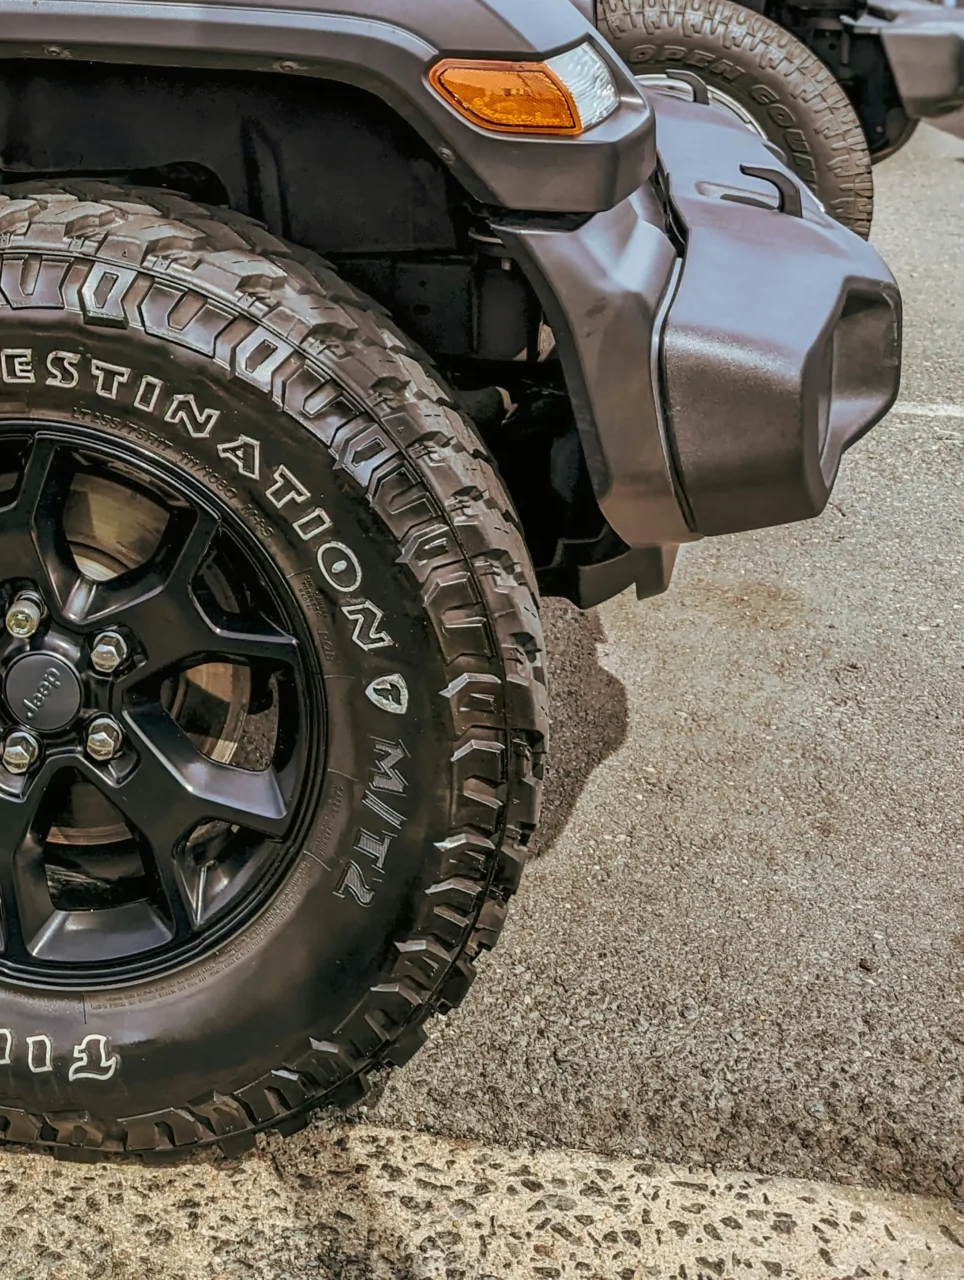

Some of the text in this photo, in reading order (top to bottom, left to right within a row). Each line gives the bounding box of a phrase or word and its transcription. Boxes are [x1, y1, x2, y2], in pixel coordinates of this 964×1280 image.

[628, 44, 818, 192] OPEN COUN
[23, 667, 61, 719] Jeep
